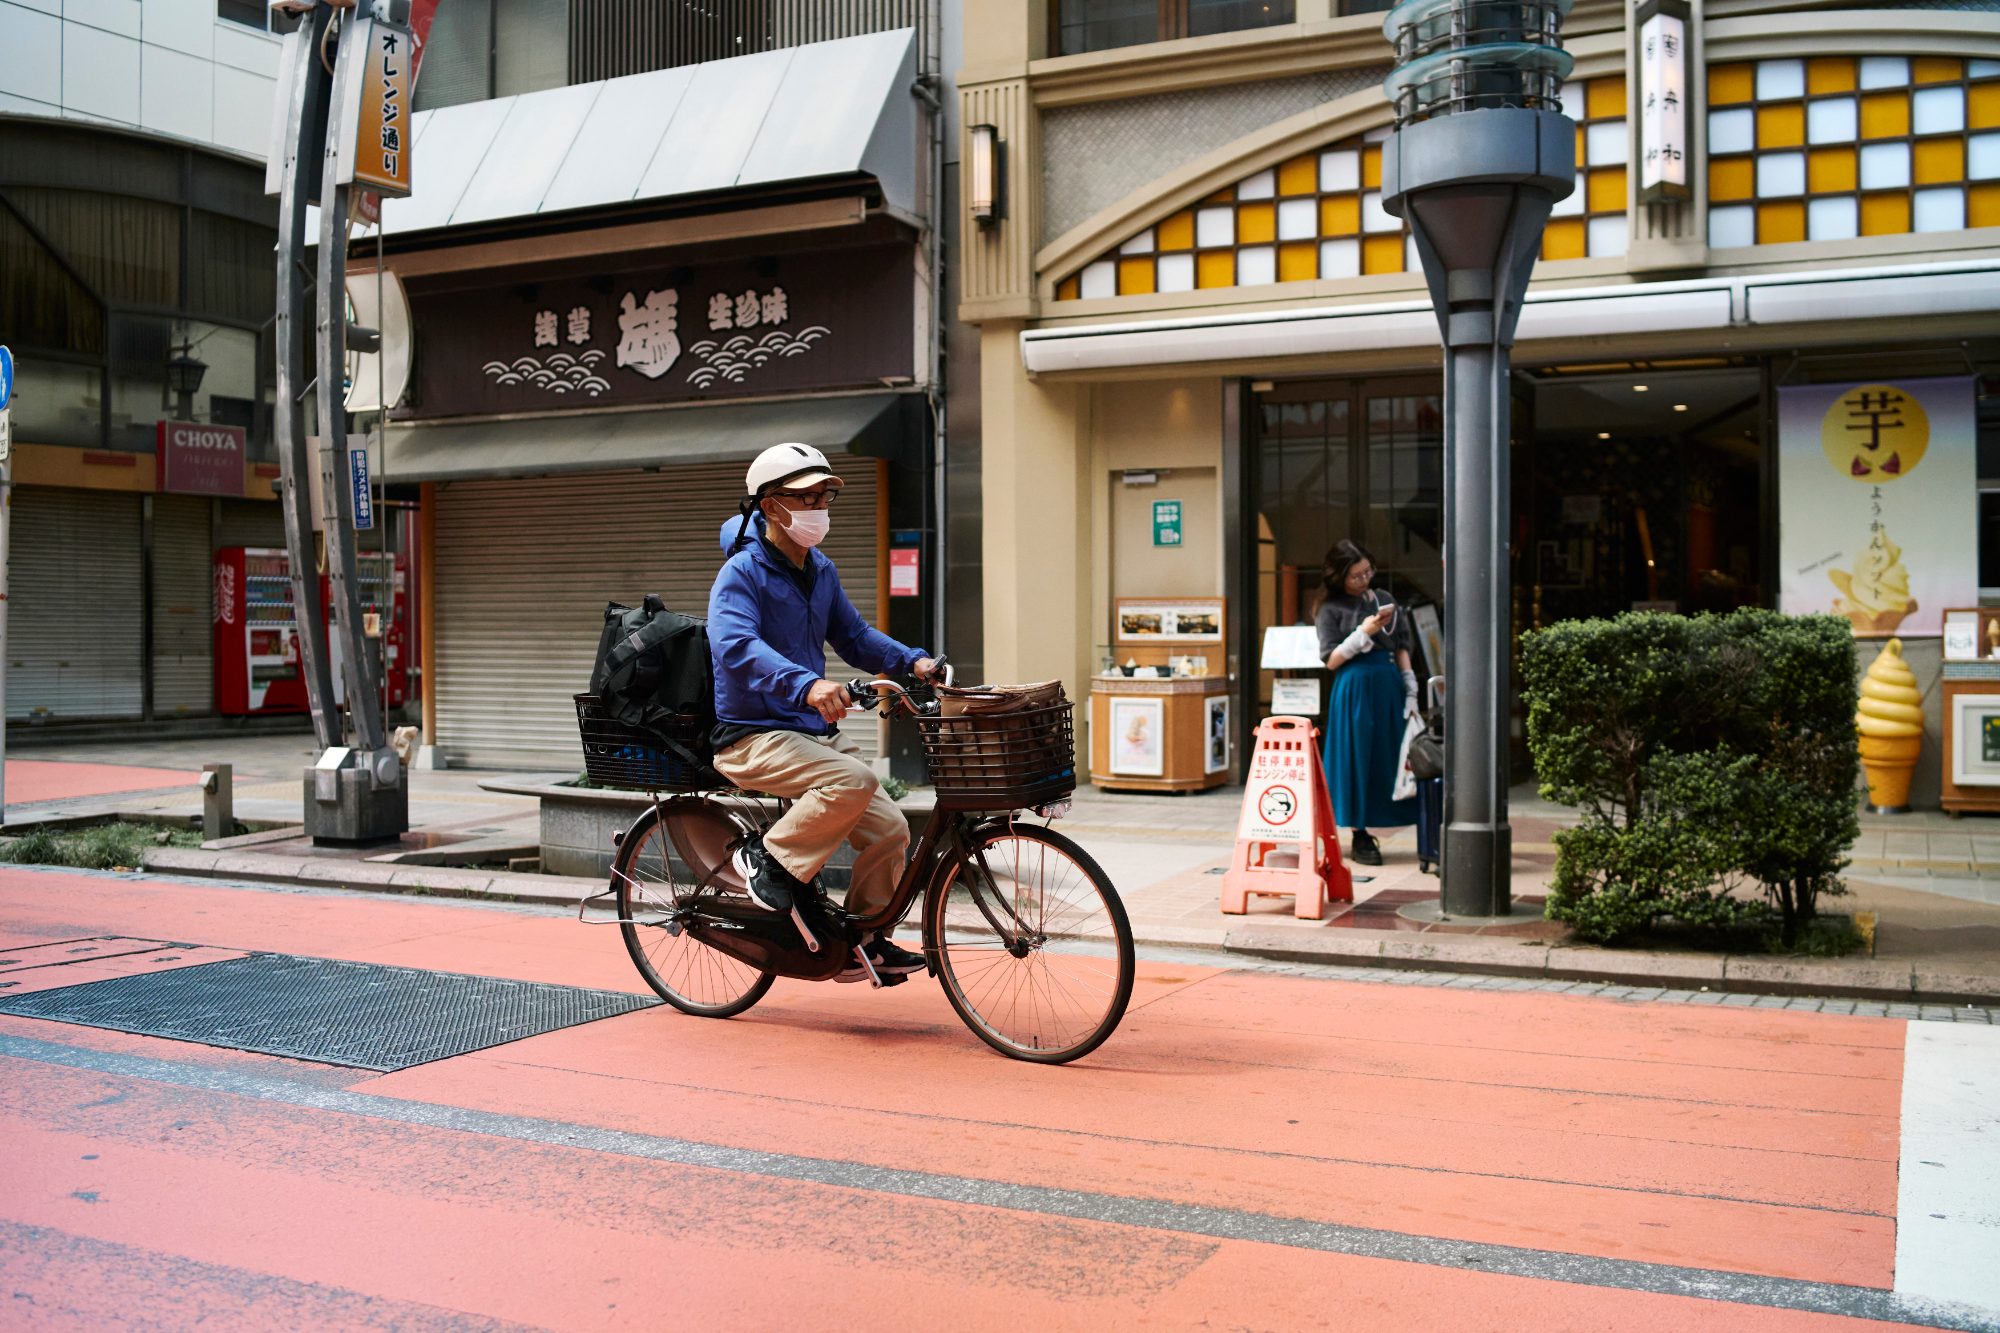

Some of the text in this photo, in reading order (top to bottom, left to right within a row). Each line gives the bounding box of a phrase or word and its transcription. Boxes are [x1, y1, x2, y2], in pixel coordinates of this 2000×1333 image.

[382, 33, 400, 177] オレンジ通り
[535, 306, 591, 347] 浅草
[708, 286, 788, 330] 生珍味
[174, 430, 237, 450] CHOYA
[1845, 392, 1904, 451] 芋
[1870, 485, 1886, 600] ようかんソフト
[1254, 769, 1306, 781] エンジン停止
[1258, 756, 1304, 767] 駐停車時
